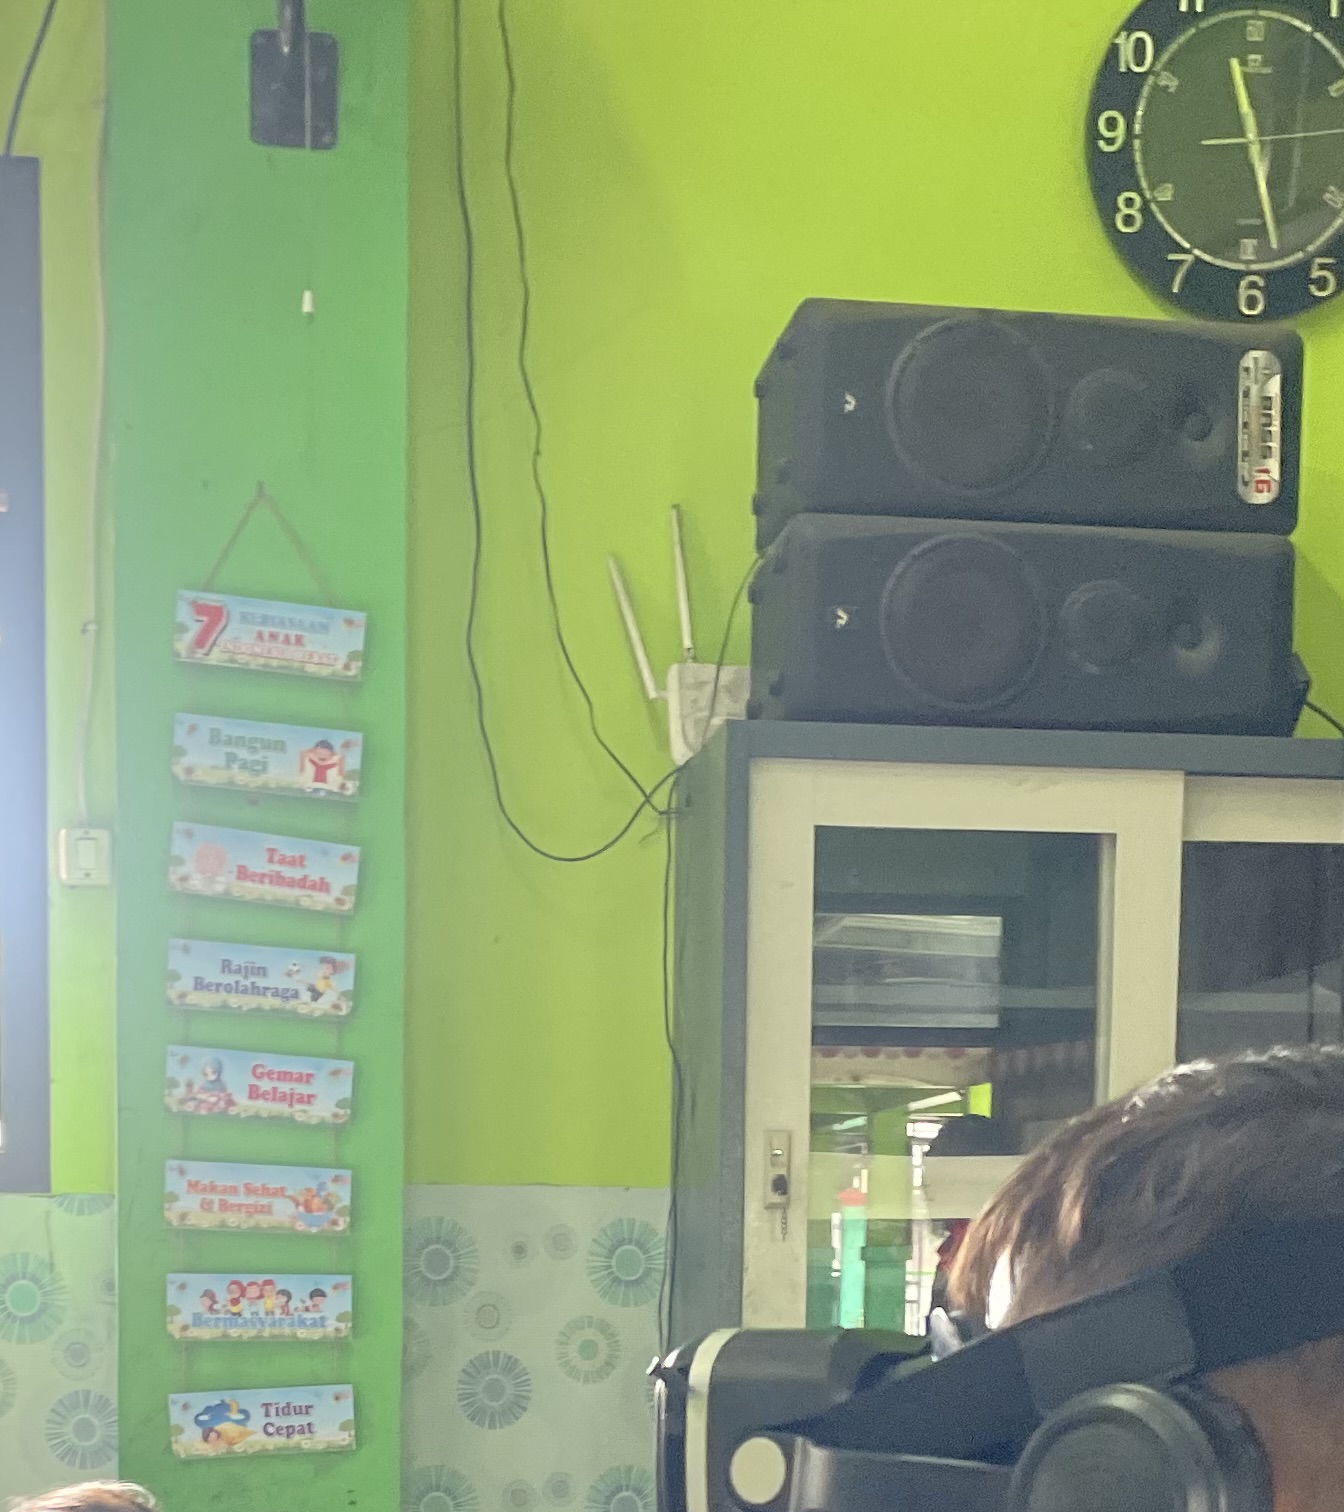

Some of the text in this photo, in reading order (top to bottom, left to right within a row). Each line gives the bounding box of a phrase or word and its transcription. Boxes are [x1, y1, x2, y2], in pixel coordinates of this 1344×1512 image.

[1114, 31, 1155, 73] 10
[1097, 110, 1126, 153] 9
[1114, 192, 1143, 233] 8
[1167, 253, 1196, 293] 7
[1308, 257, 1338, 297] 5
[1237, 275, 1266, 316] 6
[191, 600, 230, 657] 7
[208, 727, 288, 754] Bangun
[225, 752, 269, 776] Pagi
[265, 848, 307, 869] Taat
[235, 864, 332, 893] Beribadah
[220, 958, 268, 979] Rajin
[192, 976, 301, 1001] Berolahraga
[250, 1063, 315, 1085] Gemar
[247, 1084, 318, 1109] Belajar
[186, 1178, 288, 1199] Makan Sehat
[260, 1402, 314, 1419] Tidur
[263, 1421, 315, 1439] Cepat
